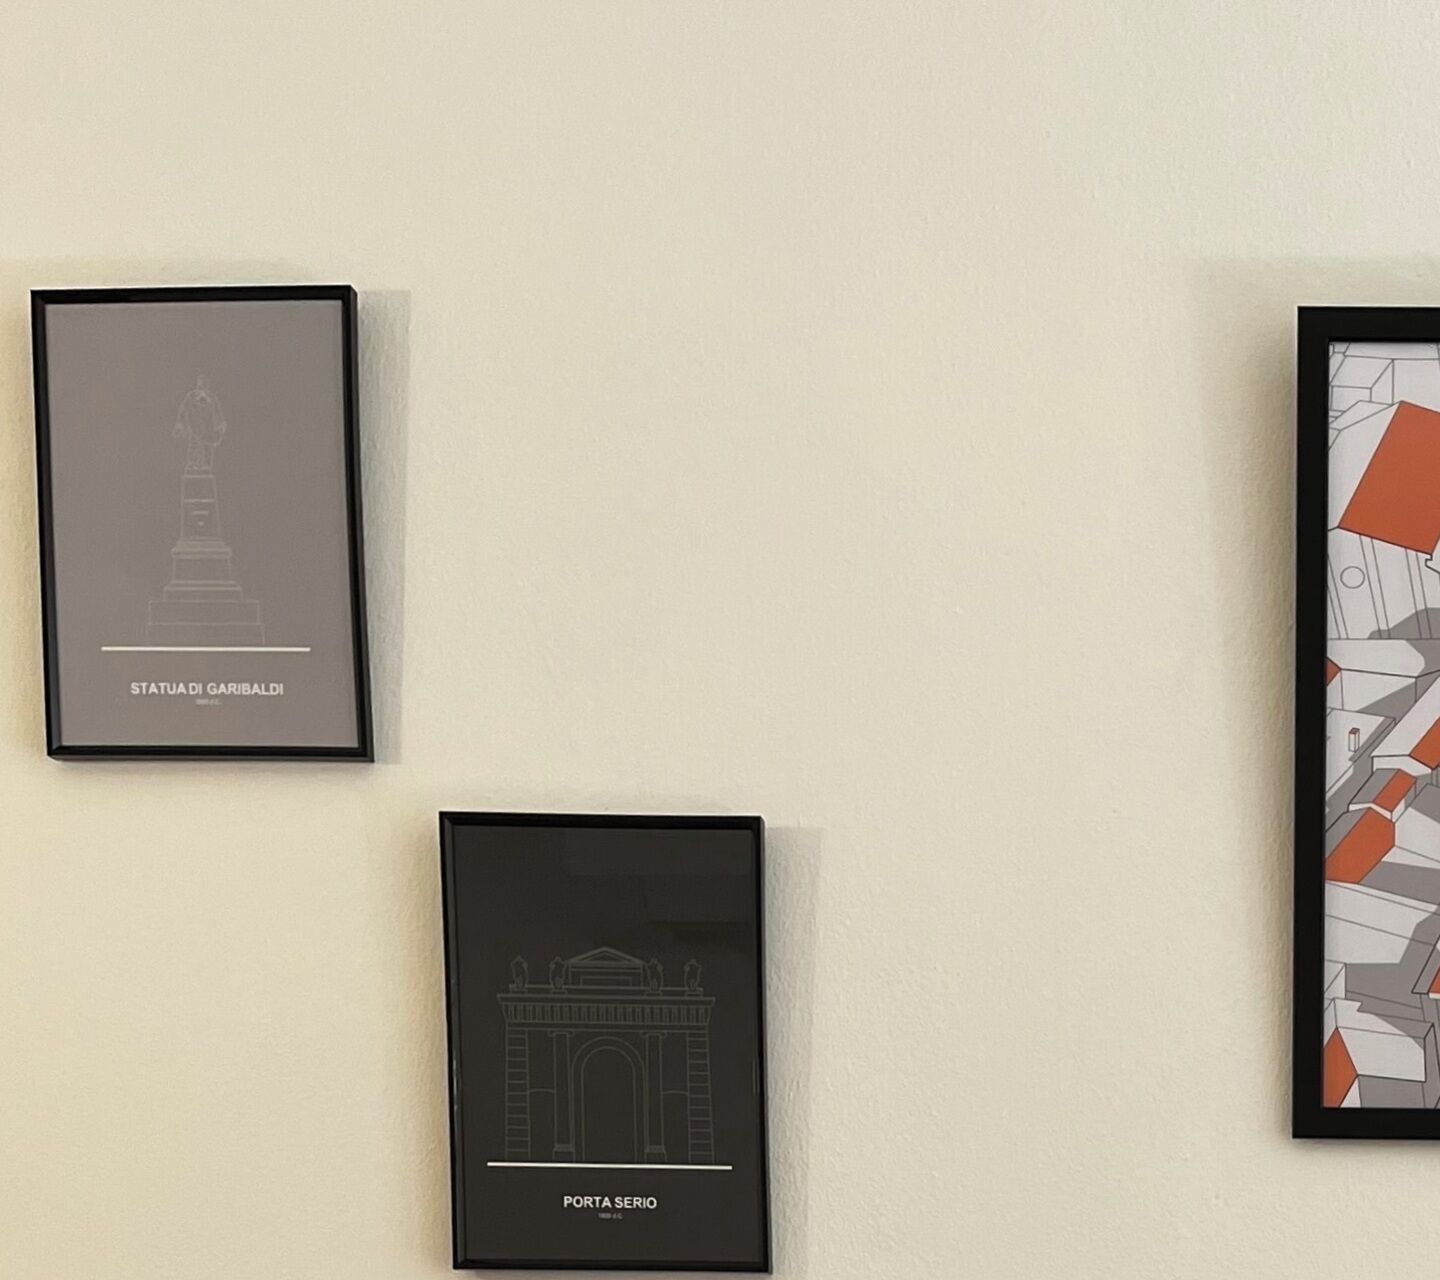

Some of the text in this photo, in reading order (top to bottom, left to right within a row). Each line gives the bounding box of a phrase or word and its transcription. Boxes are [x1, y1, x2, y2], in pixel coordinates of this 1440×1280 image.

[130, 682, 284, 696] STATUA DI GARIBALDI
[563, 1195, 657, 1209] PORTA SERIO
